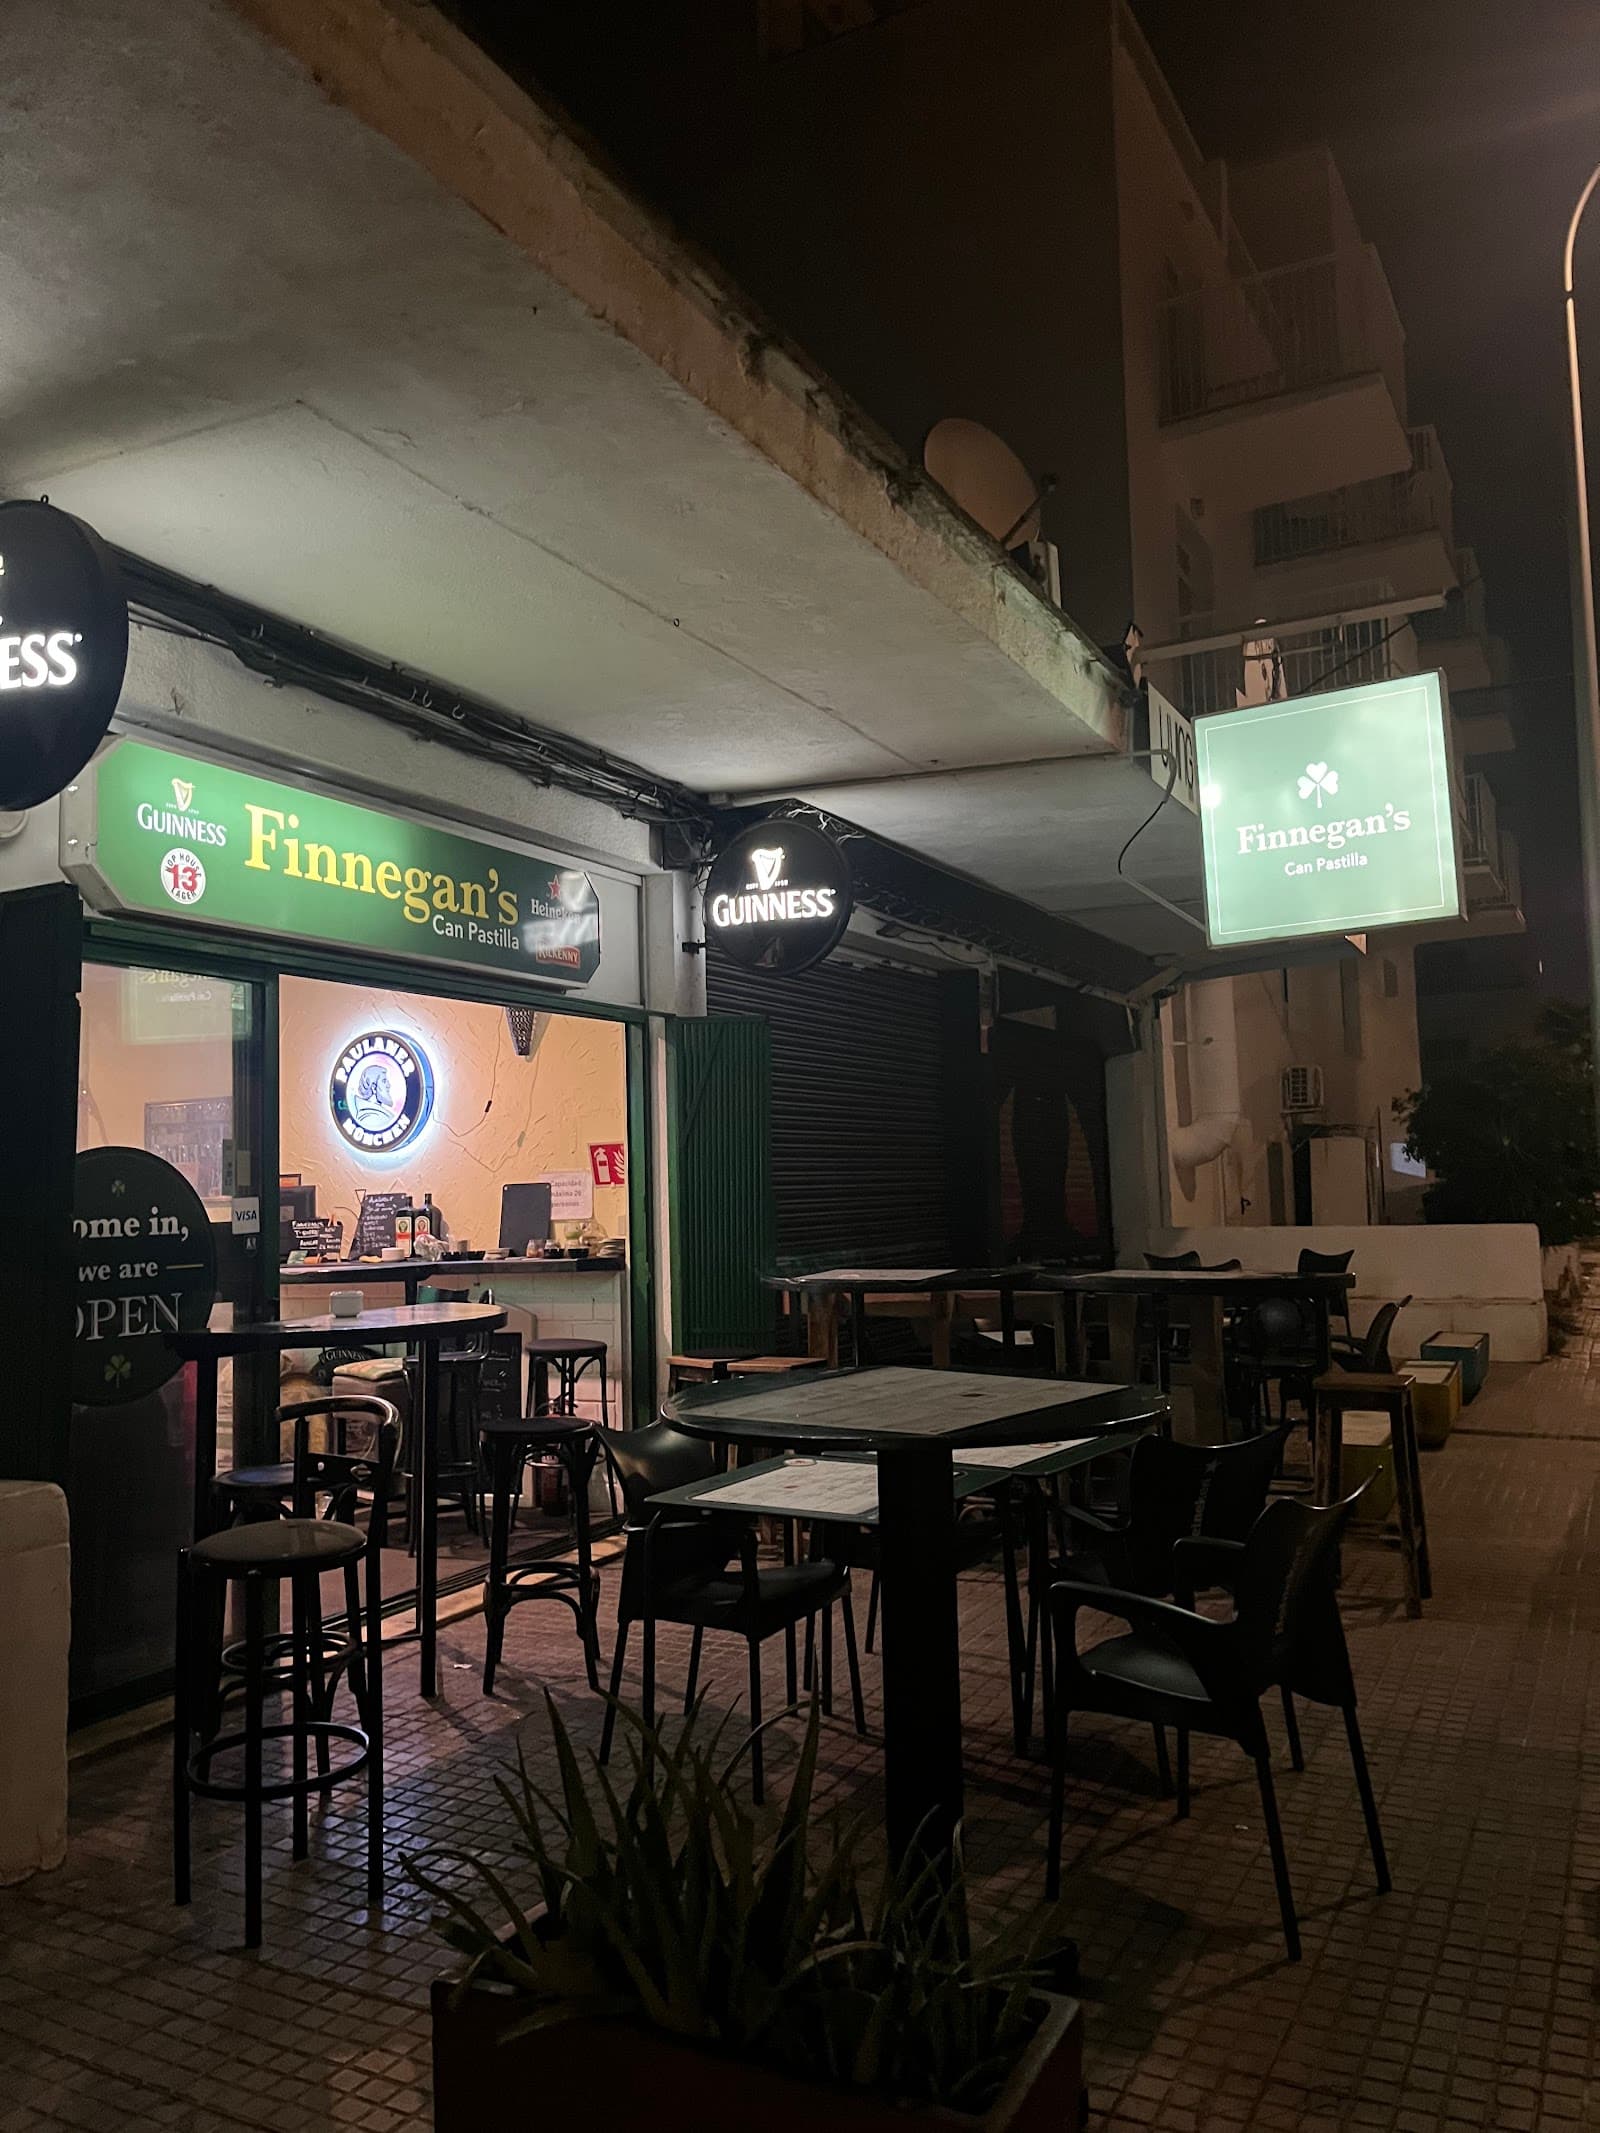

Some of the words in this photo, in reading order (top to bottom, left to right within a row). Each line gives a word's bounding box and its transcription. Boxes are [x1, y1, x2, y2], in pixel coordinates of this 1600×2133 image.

[137, 803, 227, 846] GUINNESS
[1236, 803, 1411, 854] Finnegan's
[170, 864, 198, 892] 13
[244, 803, 519, 926] Finnegan's
[1284, 862, 1313, 876] Can
[1316, 852, 1369, 872] Pastilla
[712, 889, 834, 927] GUINNESS
[432, 915, 464, 940] Can
[468, 922, 520, 950] Pastilla
[335, 1036, 416, 1083] PAULANER
[73, 1217, 140, 1239] ome
[148, 1206, 189, 1242] in,
[235, 1210, 257, 1222] VISA
[78, 1264, 111, 1282] we
[119, 1261, 159, 1279] are
